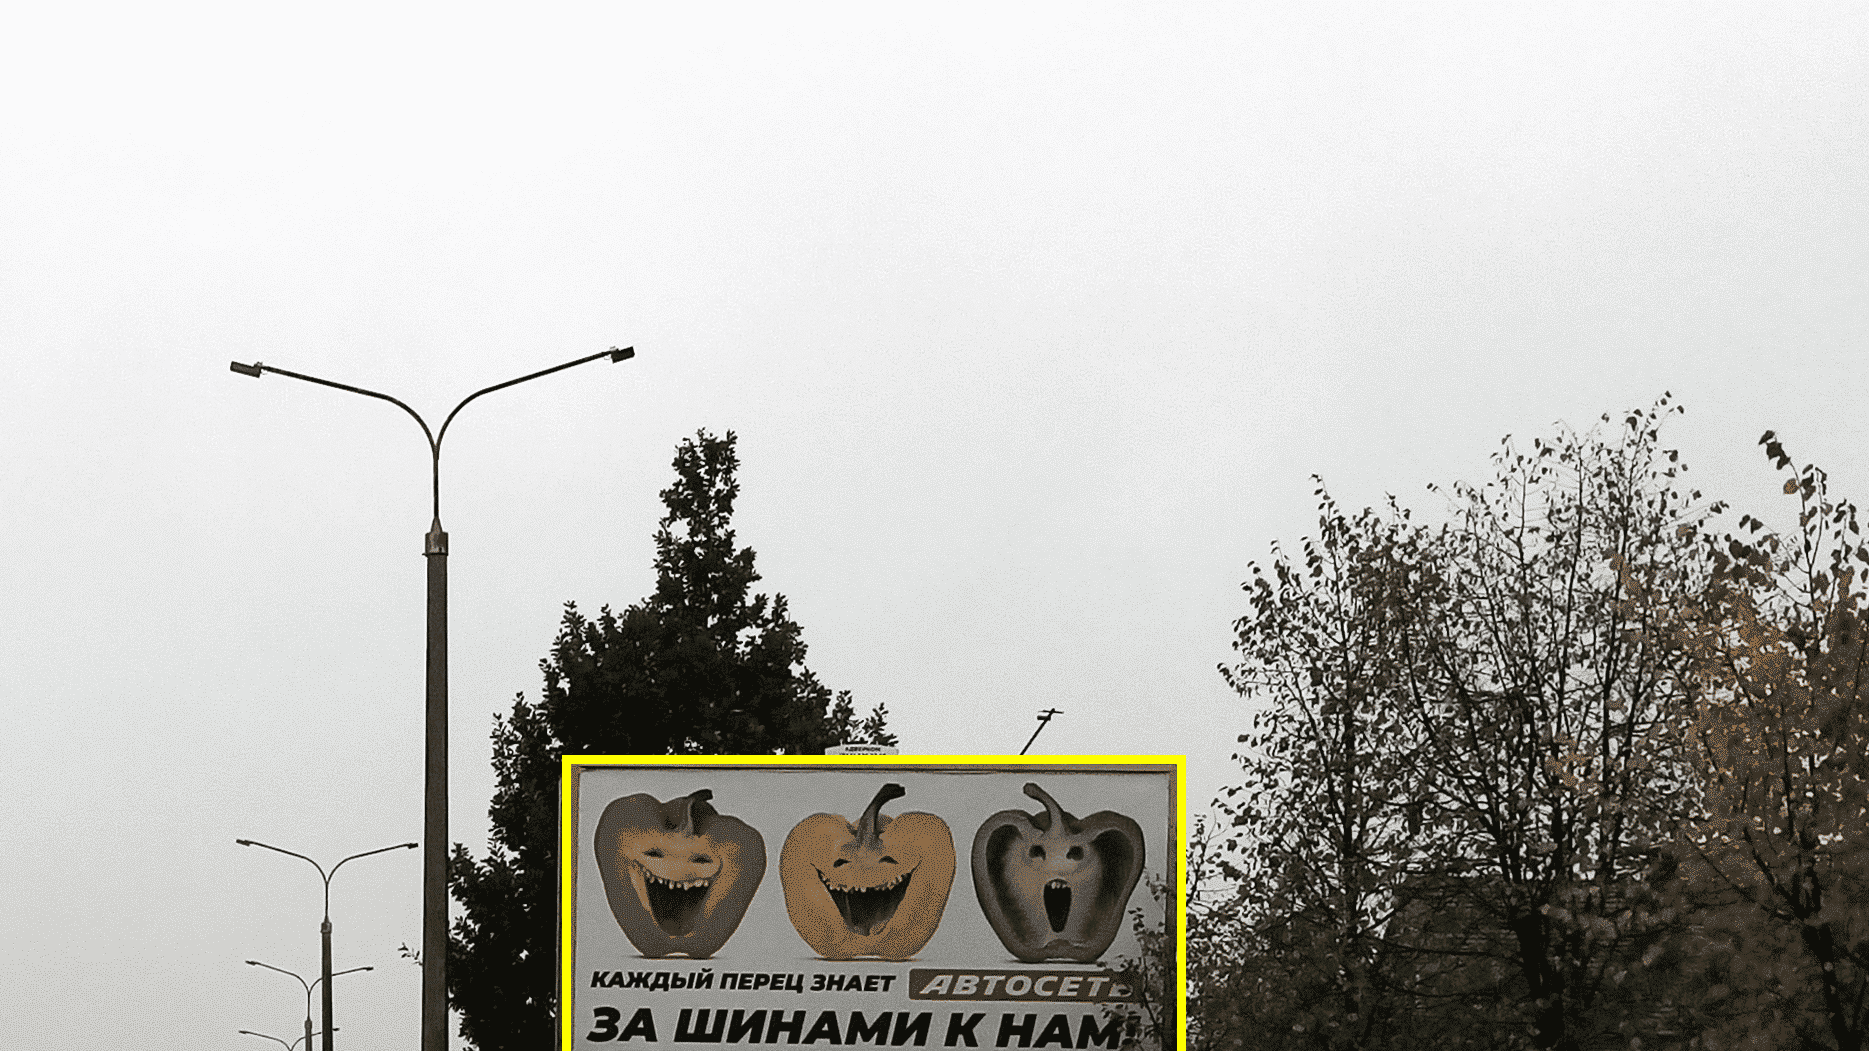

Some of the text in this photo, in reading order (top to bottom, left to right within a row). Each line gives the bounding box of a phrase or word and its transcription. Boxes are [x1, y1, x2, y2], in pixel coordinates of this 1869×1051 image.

[590, 968, 1132, 998] КАЖДЫЙ ПЕРЕЦ ЗНАЕТ АВТОСЕТЬ
[586, 1006, 658, 1043] ЗА
[674, 1008, 932, 1047] ШИНАМИ
[944, 1012, 986, 1047] К
